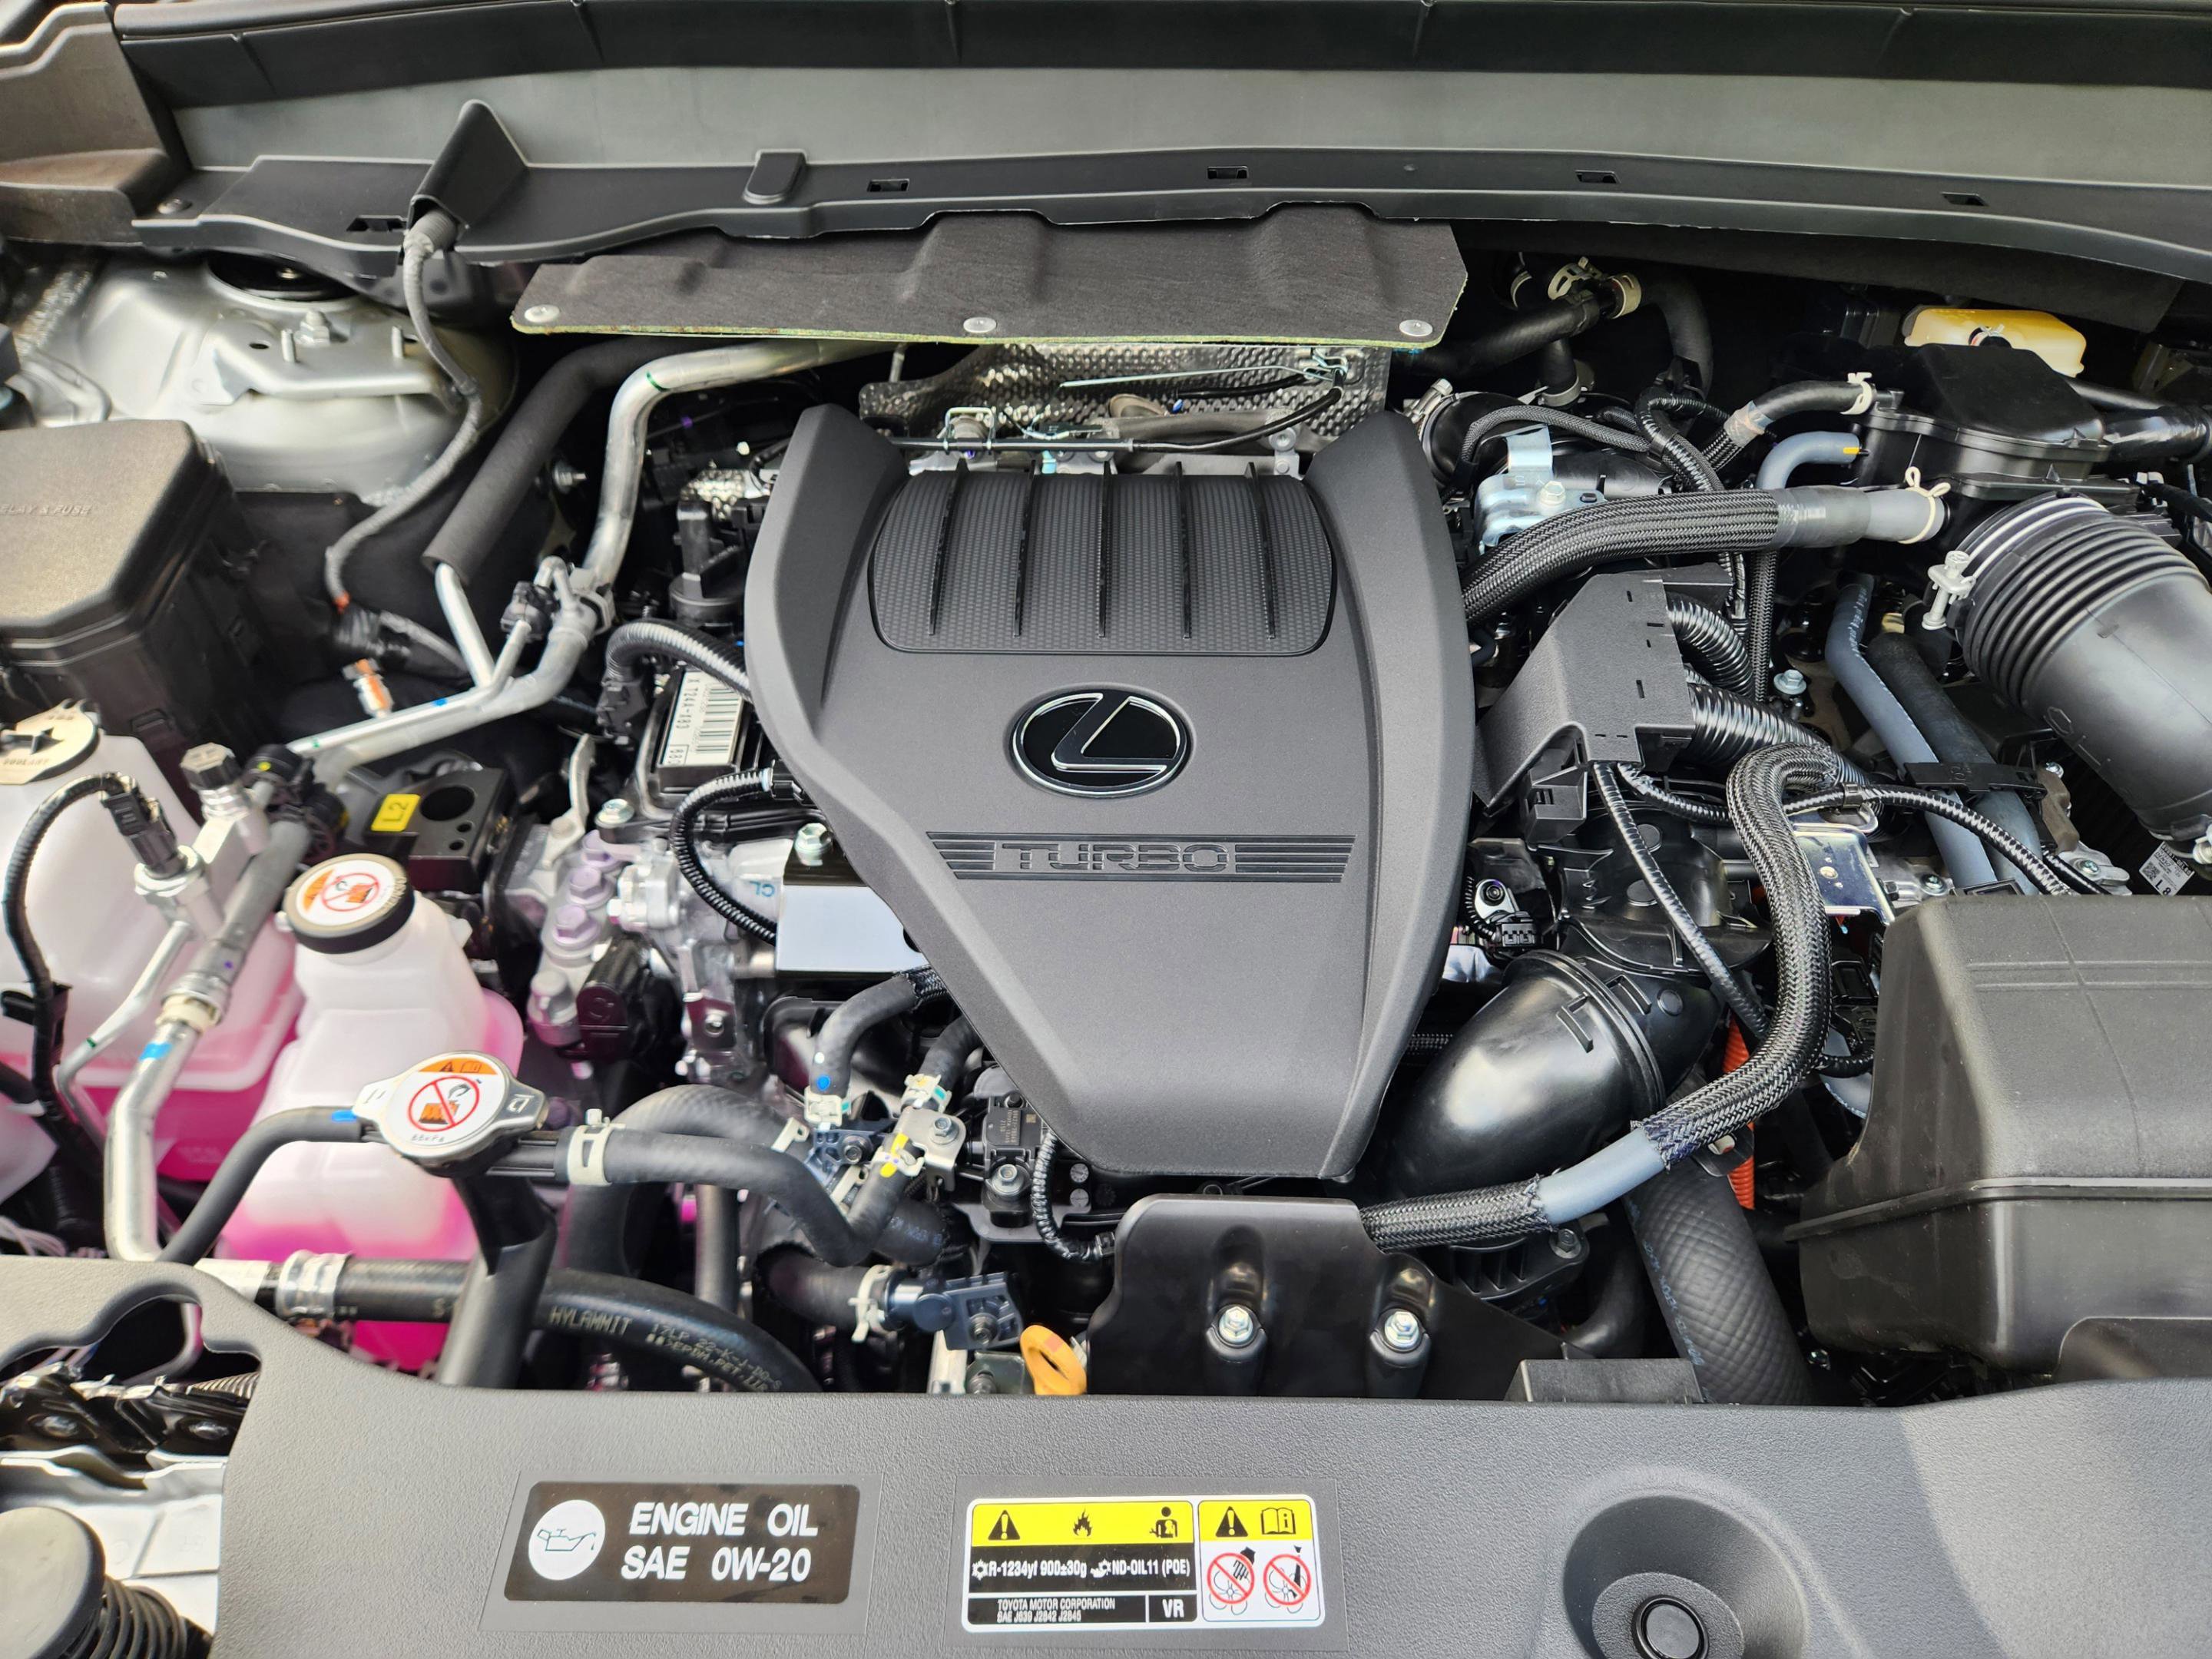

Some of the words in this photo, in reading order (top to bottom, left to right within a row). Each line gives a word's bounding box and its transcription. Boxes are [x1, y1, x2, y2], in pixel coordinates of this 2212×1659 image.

[1002, 843, 1229, 870] TURBO
[548, 1306, 633, 1336] HYLAMMIT
[629, 1502, 749, 1536] ENGINE
[767, 1503, 818, 1537] OIL
[620, 1545, 691, 1581] SAE
[710, 1547, 812, 1582] 0W-20
[988, 1560, 1038, 1579] R-1234yf
[1040, 1559, 1087, 1578] 900±30g
[1112, 1559, 1159, 1575] ND-OIL11
[1162, 1558, 1190, 1578] (POE)
[997, 1599, 1028, 1611] TOYOTA
[1029, 1598, 1058, 1611] MOTOR
[1059, 1598, 1115, 1611] CORPORATION
[997, 1611, 1013, 1623] SAE
[1014, 1611, 1033, 1623] J639
[1034, 1611, 1057, 1622] J2842
[1058, 1610, 1081, 1622] J2845
[1162, 1599, 1185, 1619] VR
